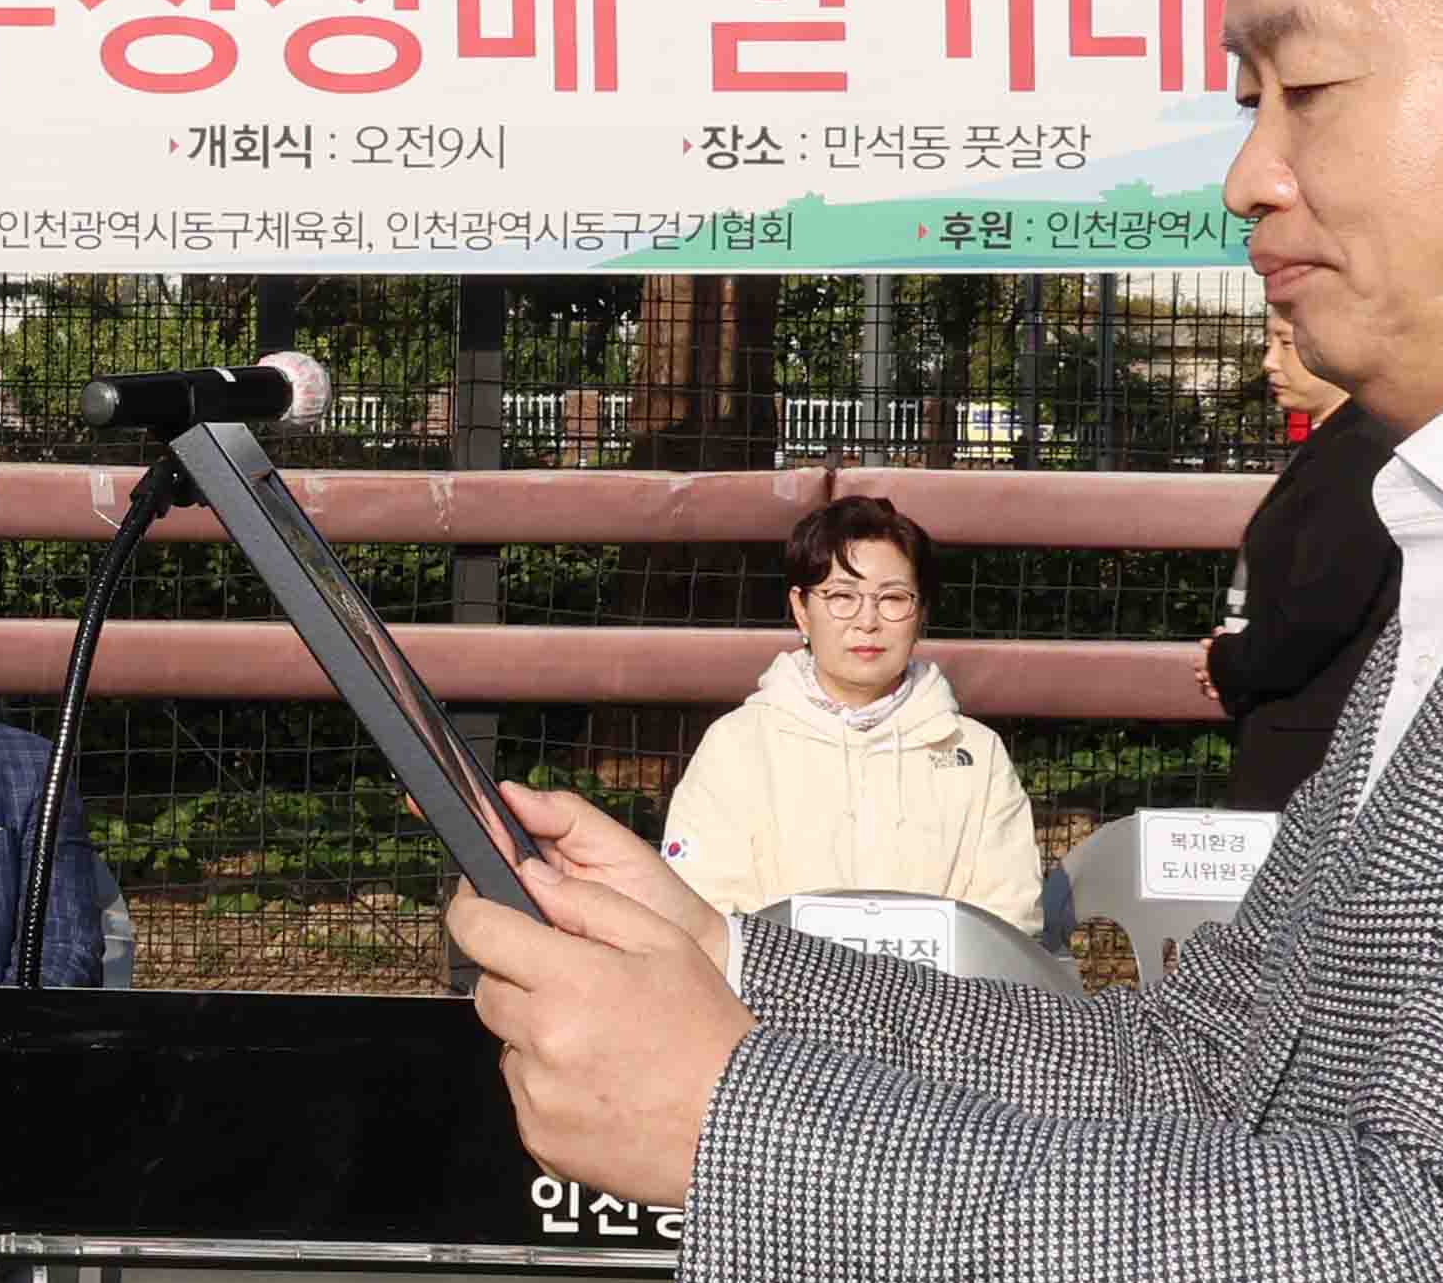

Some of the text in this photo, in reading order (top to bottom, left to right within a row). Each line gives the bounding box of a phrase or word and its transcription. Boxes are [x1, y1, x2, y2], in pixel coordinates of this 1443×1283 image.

[188, 124, 312, 169] 개회식
[352, 125, 504, 169] 오전9시
[699, 125, 785, 170] 장소
[824, 125, 950, 170] 만석동
[962, 125, 1092, 170] 풋살장
[387, 211, 793, 251] 인천광역시동구걷기협회
[939, 211, 1012, 250] 후원
[1047, 210, 1227, 250] 인천광역시
[1170, 832, 1245, 853] 복지환경
[1162, 861, 1256, 882] 도시위원장
